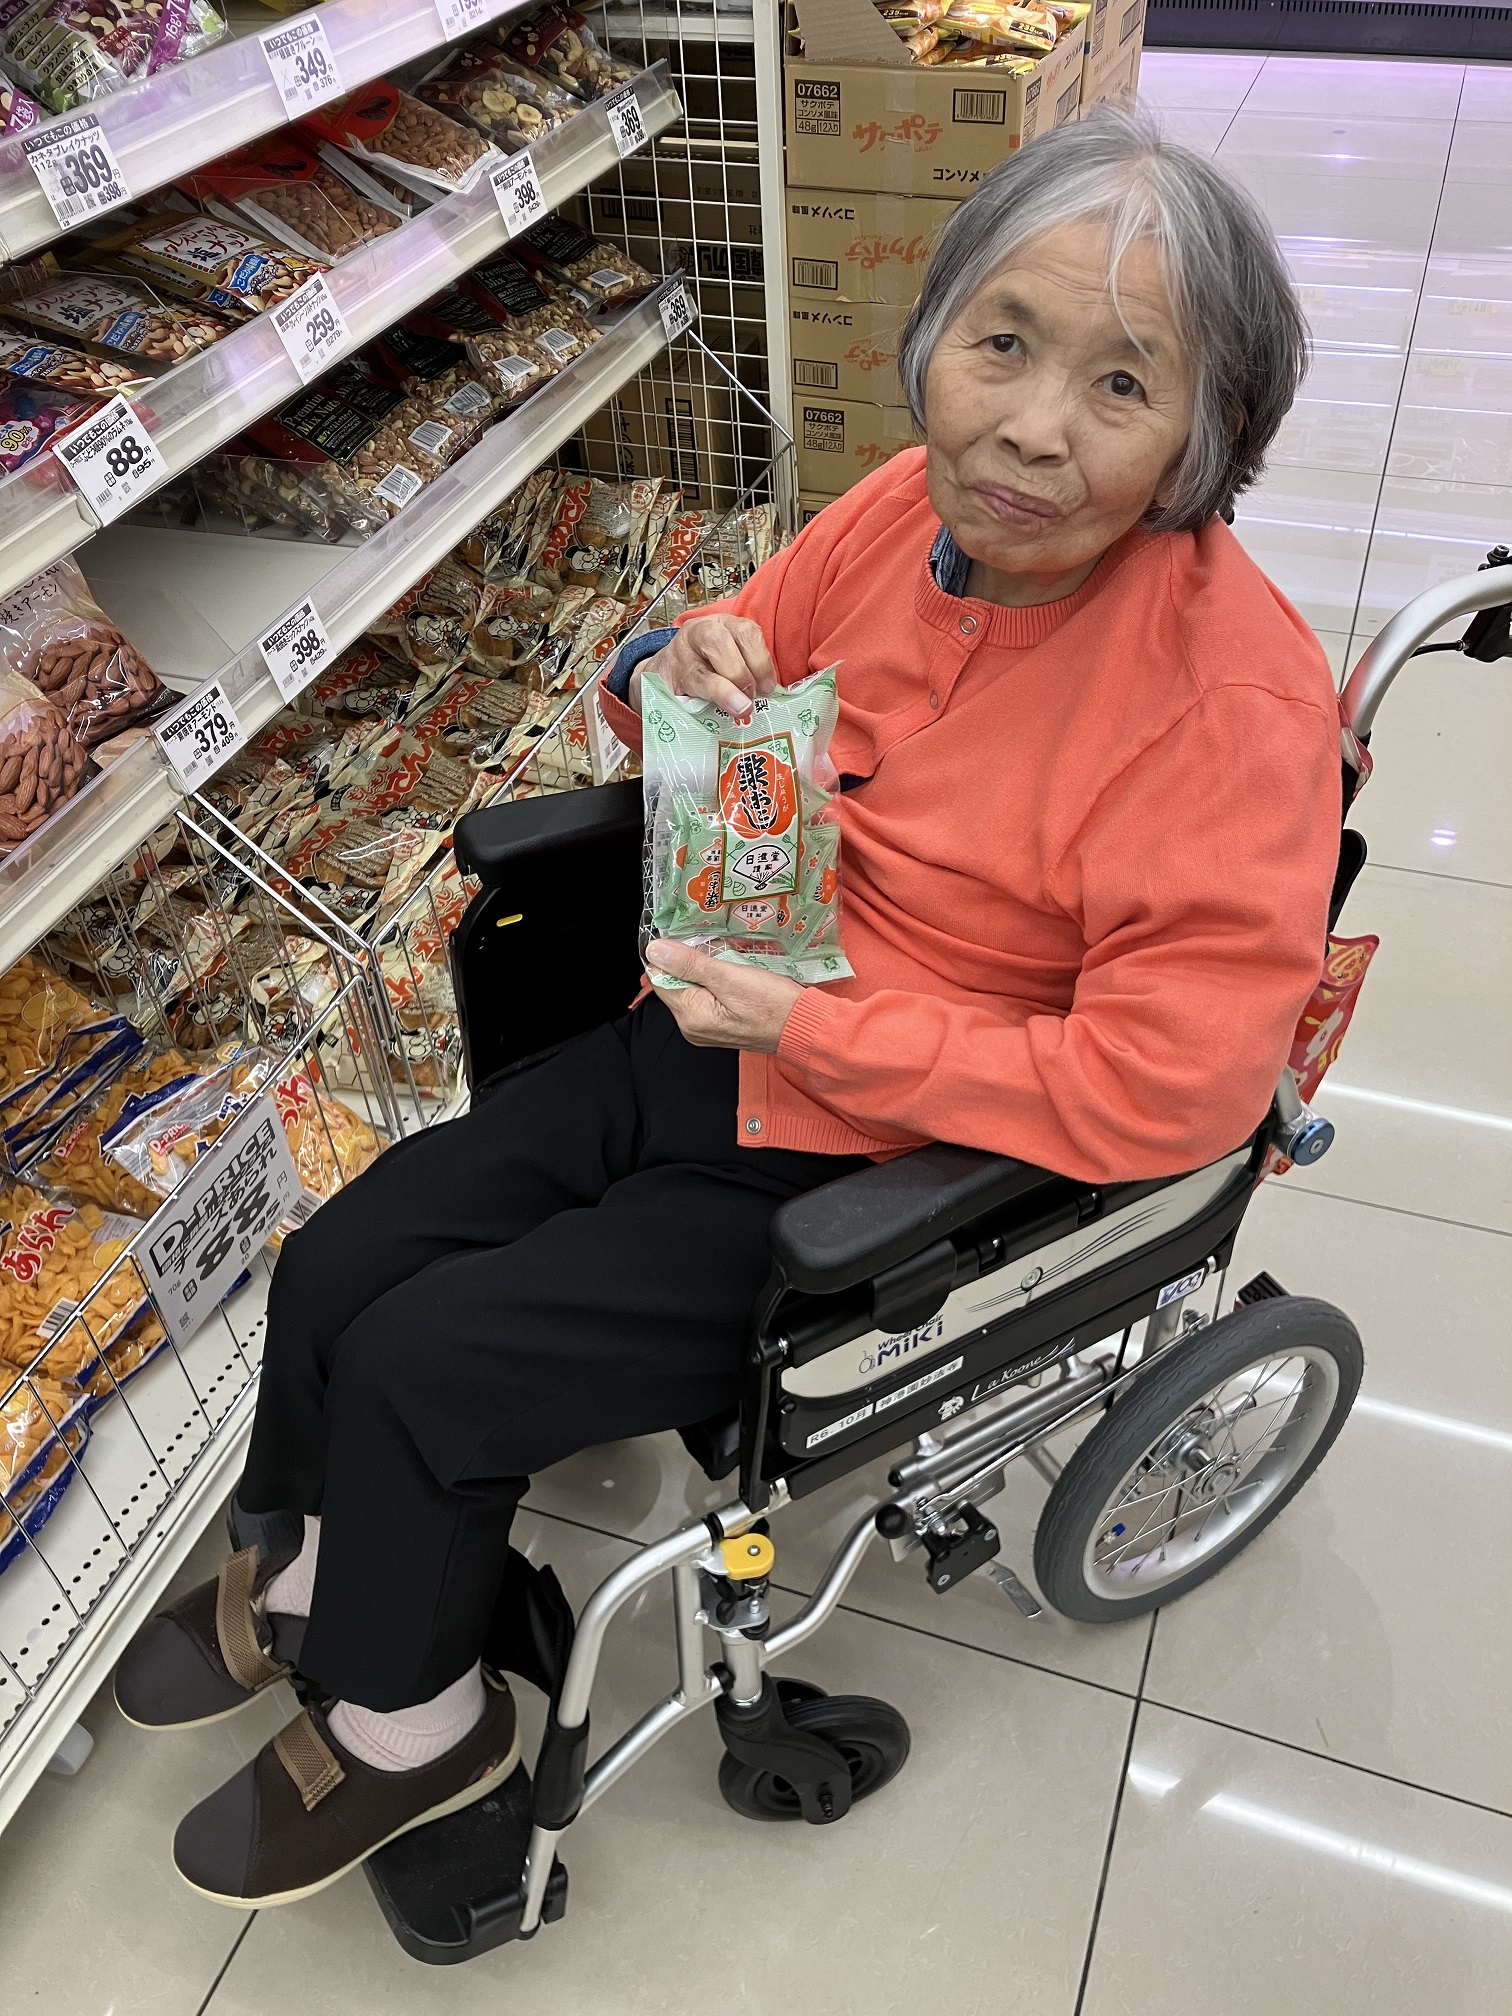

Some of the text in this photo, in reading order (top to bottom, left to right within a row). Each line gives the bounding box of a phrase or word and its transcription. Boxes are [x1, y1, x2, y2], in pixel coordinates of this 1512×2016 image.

[18, 30, 43, 56] アーモンド
[31, 44, 50, 65] レーズン
[43, 43, 71, 74] クランベリー
[295, 47, 327, 83] 349
[320, 75, 332, 88] 376
[797, 83, 838, 98] 07662
[798, 109, 838, 119] コンソメ風味
[801, 100, 835, 109] サクポテ
[24, 117, 95, 151] いつでもこの価格!
[622, 106, 640, 136] 369
[799, 121, 838, 133] 48g 12入り
[65, 144, 112, 193] 369
[933, 168, 986, 183] コンソメ
[102, 181, 121, 201] 398
[515, 180, 536, 208] 398
[485, 275, 506, 289] Mix
[671, 295, 686, 322] 369
[306, 308, 335, 346] 259
[297, 414, 321, 435] Mix
[314, 400, 340, 418] Nuts
[806, 410, 842, 423] 07662
[808, 423, 840, 432] サクポテ
[106, 436, 143, 477] 88
[136, 459, 151, 475] 95
[292, 629, 320, 665] 398
[195, 713, 228, 753] 379
[222, 732, 235, 748] 409
[746, 851, 780, 864] 日進堂
[741, 905, 767, 913] 日進堂
[150, 1117, 275, 1277] D-PRICE
[173, 1149, 277, 1275] チーズあられ
[252, 1198, 280, 1237] 95
[196, 1173, 270, 1281] 88
[1, 1208, 75, 1282] あられ
